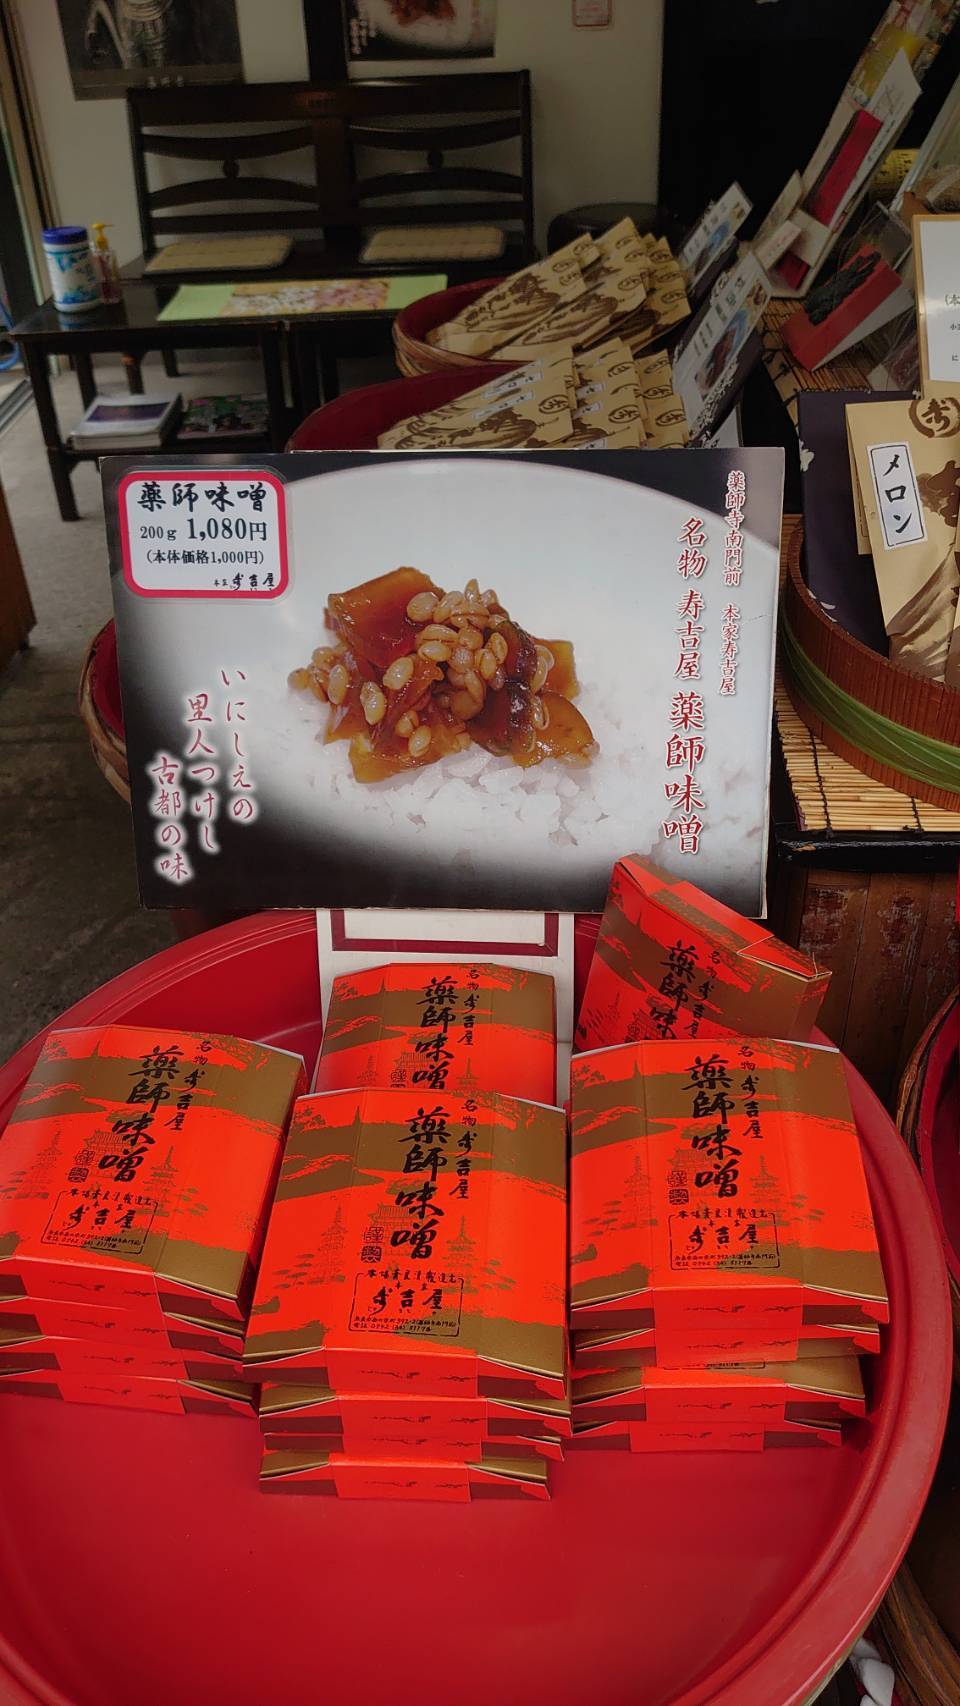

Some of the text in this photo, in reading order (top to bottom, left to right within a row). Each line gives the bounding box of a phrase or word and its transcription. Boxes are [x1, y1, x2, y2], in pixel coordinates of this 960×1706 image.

[136, 481, 267, 513] 薬師味噌
[186, 517, 268, 542] 1,080円
[882, 453, 913, 534] メロン
[146, 549, 265, 565] (本体価格1,000円)
[718, 470, 746, 696] 薬師寺南門前 本家寿吉屋
[219, 668, 255, 821] いにしえの
[662, 516, 708, 856] 名物 寿吉屋 薬師味噌
[150, 755, 190, 881] 古都の味
[187, 692, 216, 850] 里人つけし
